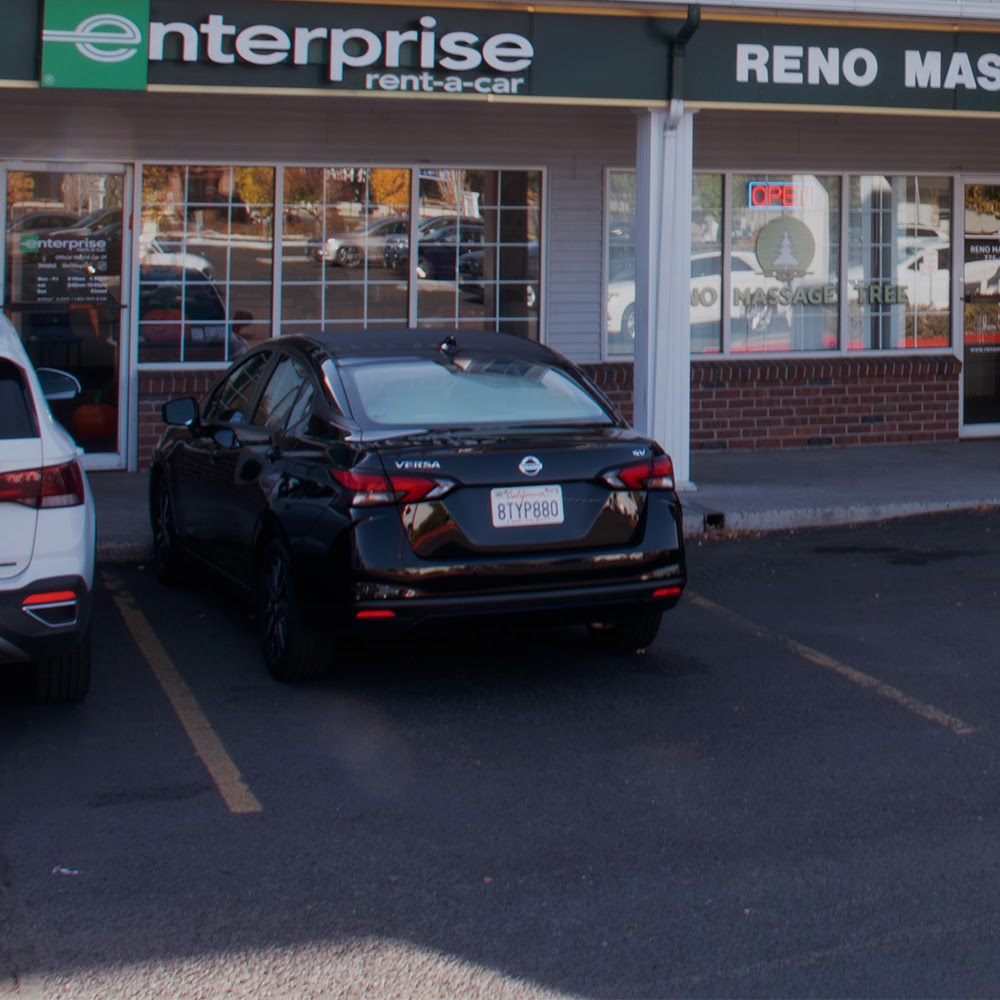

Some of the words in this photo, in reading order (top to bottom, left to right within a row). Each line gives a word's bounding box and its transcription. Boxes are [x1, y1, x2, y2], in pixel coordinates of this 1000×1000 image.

[43, 13, 535, 81] enterprise
[735, 43, 878, 87] RENO
[365, 70, 524, 94] rent-a-car
[970, 244, 991, 254] RENO
[733, 284, 836, 306] MASSAGE
[855, 284, 909, 304] TREE
[395, 460, 441, 470] VERSA
[497, 500, 559, 520] 8TYP880
